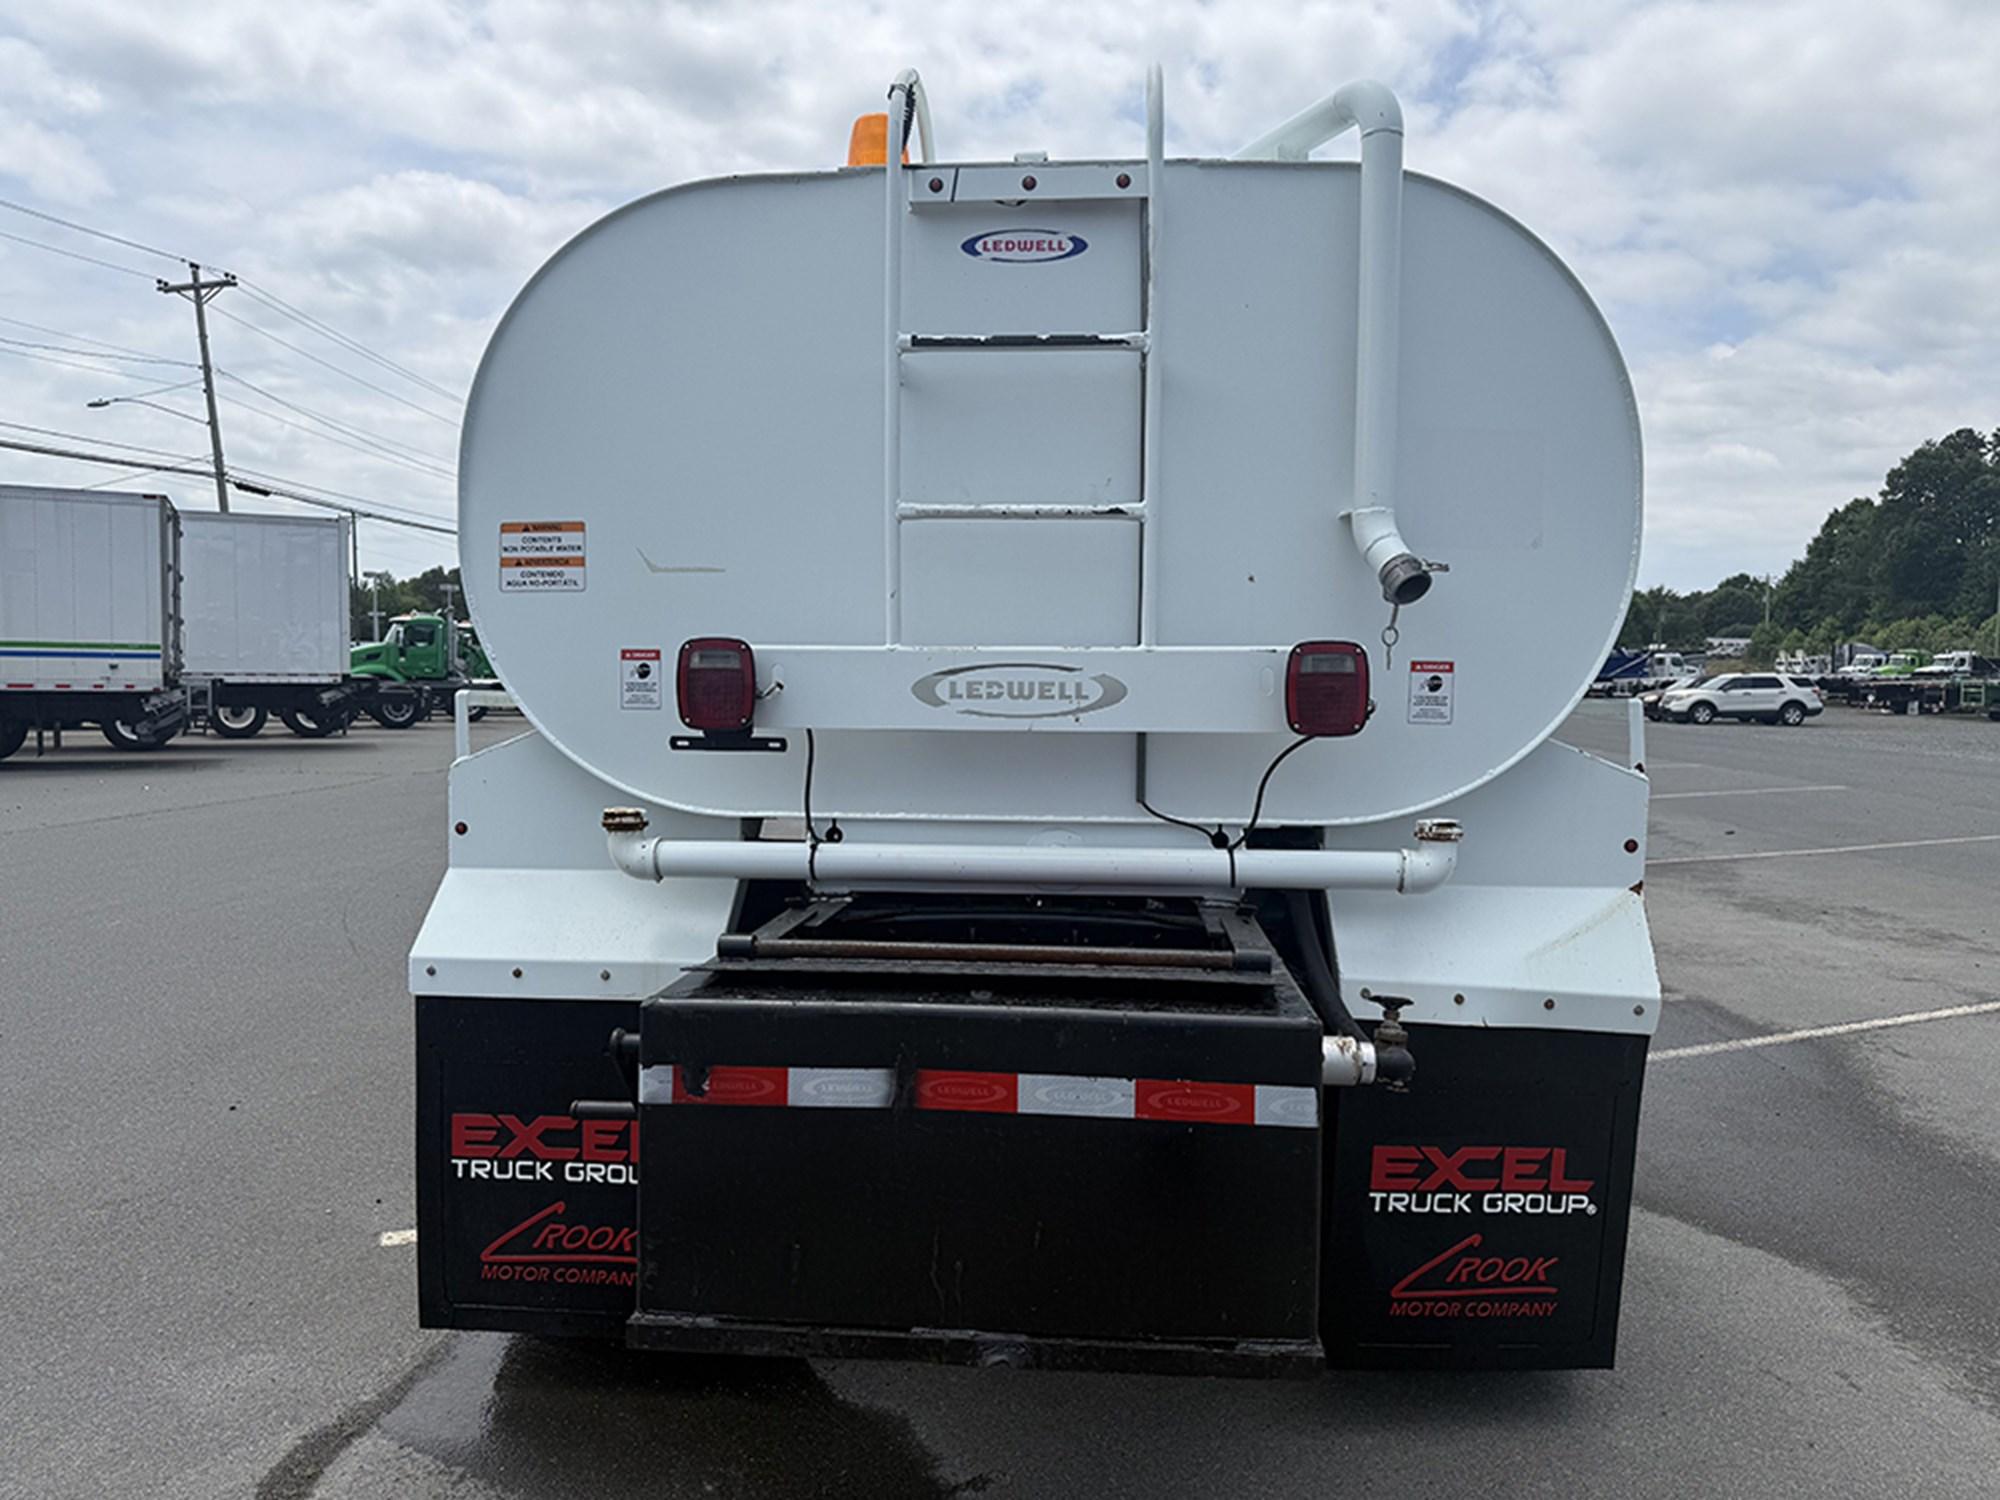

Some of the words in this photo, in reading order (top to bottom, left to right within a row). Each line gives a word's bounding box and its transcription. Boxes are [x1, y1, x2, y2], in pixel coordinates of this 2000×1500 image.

[982, 239, 1066, 252] LEDWELL
[521, 535, 562, 544] CONTENTS
[556, 544, 582, 552] WATER
[949, 680, 1089, 700] LEDWELL
[451, 1113, 639, 1164] EXCE
[451, 1159, 554, 1181] TRUCK
[1370, 1145, 1595, 1193] EXCEL
[1369, 1193, 1472, 1213] TRUCK
[481, 1264, 550, 1281] MOTOR
[553, 1267, 639, 1287] COMPAN
[1390, 1302, 1462, 1317] MOTOR
[1464, 1302, 1558, 1317] COMPANY
